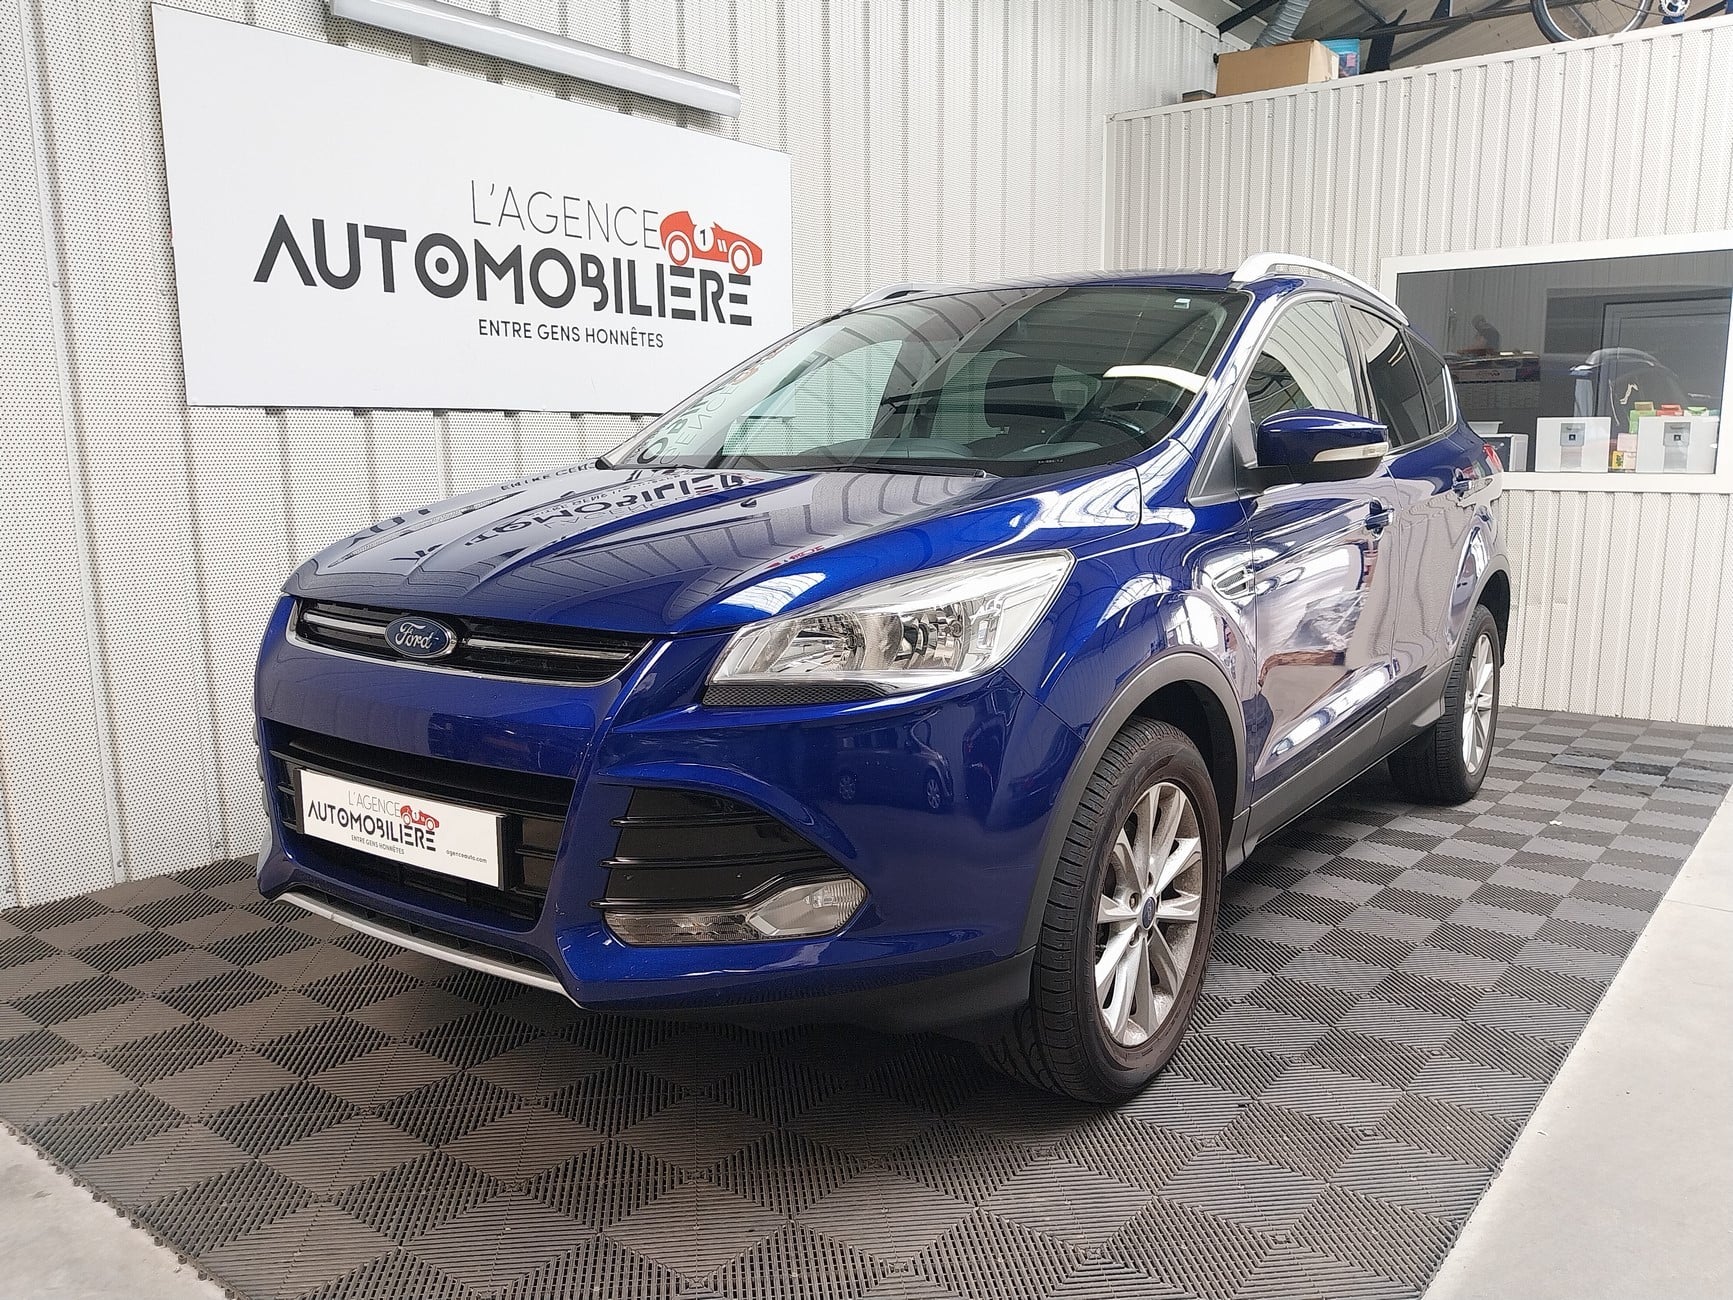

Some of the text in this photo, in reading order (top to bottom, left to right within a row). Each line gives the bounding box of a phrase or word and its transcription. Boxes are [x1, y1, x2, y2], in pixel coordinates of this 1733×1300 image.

[471, 179, 660, 250] L'AGENCE
[478, 318, 664, 348] ENTRE GENS HONNÊTES
[395, 622, 435, 649] Ford
[348, 789, 401, 818] L'AGENCE
[351, 834, 365, 845] ENTRE
[365, 838, 379, 848] GENS
[446, 849, 488, 863] agenceauto.com
